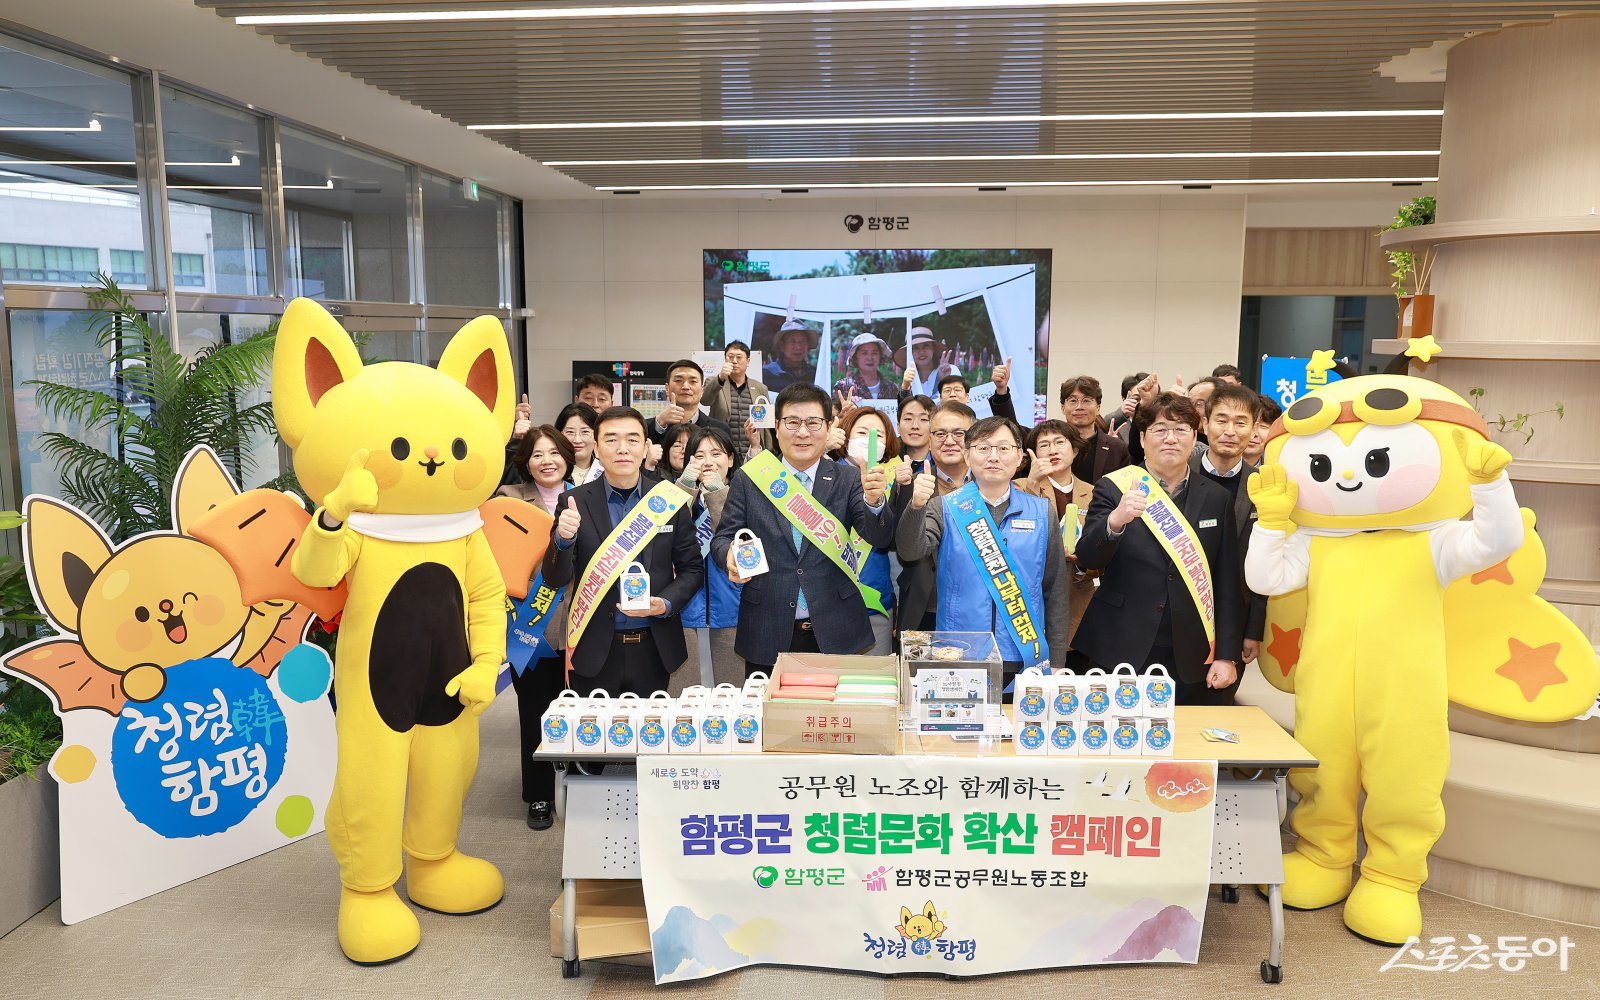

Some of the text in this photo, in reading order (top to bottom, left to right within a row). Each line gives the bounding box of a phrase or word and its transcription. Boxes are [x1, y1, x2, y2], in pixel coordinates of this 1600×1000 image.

[867, 216, 910, 231] 함평군
[736, 260, 770, 273] 함평군
[595, 544, 625, 577] 주지도
[992, 570, 1027, 617] 나부터
[160, 742, 268, 817] 함평
[651, 767, 699, 778] 새로운 도약
[673, 779, 720, 790] 희망찬 함평
[778, 774, 1065, 801] 공무원 노조와 함께하는
[680, 811, 1162, 858] 함평군 청렴문화 확산 캠페인
[784, 867, 845, 887] 함평군
[895, 868, 1088, 889] 함평군공무원노동조합
[863, 932, 907, 959] 청렴
[935, 938, 977, 961] 함평
